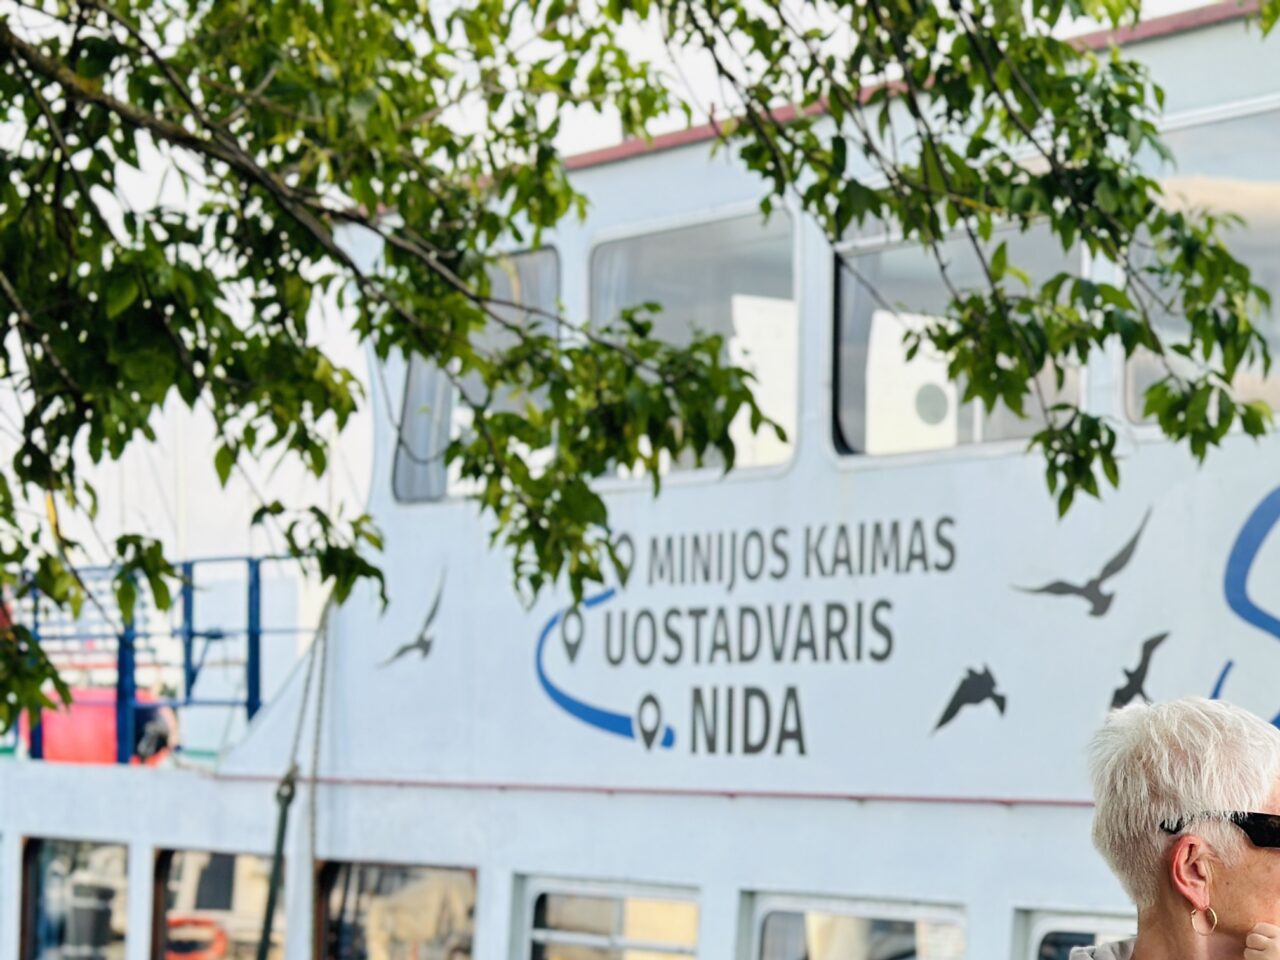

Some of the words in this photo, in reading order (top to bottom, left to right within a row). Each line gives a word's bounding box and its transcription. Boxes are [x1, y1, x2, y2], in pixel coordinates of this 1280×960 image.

[648, 528, 789, 592] MINIJOS
[803, 516, 957, 578] KAIMAS
[604, 600, 894, 667] UOSTADVARIS
[690, 685, 808, 757] NIDA
